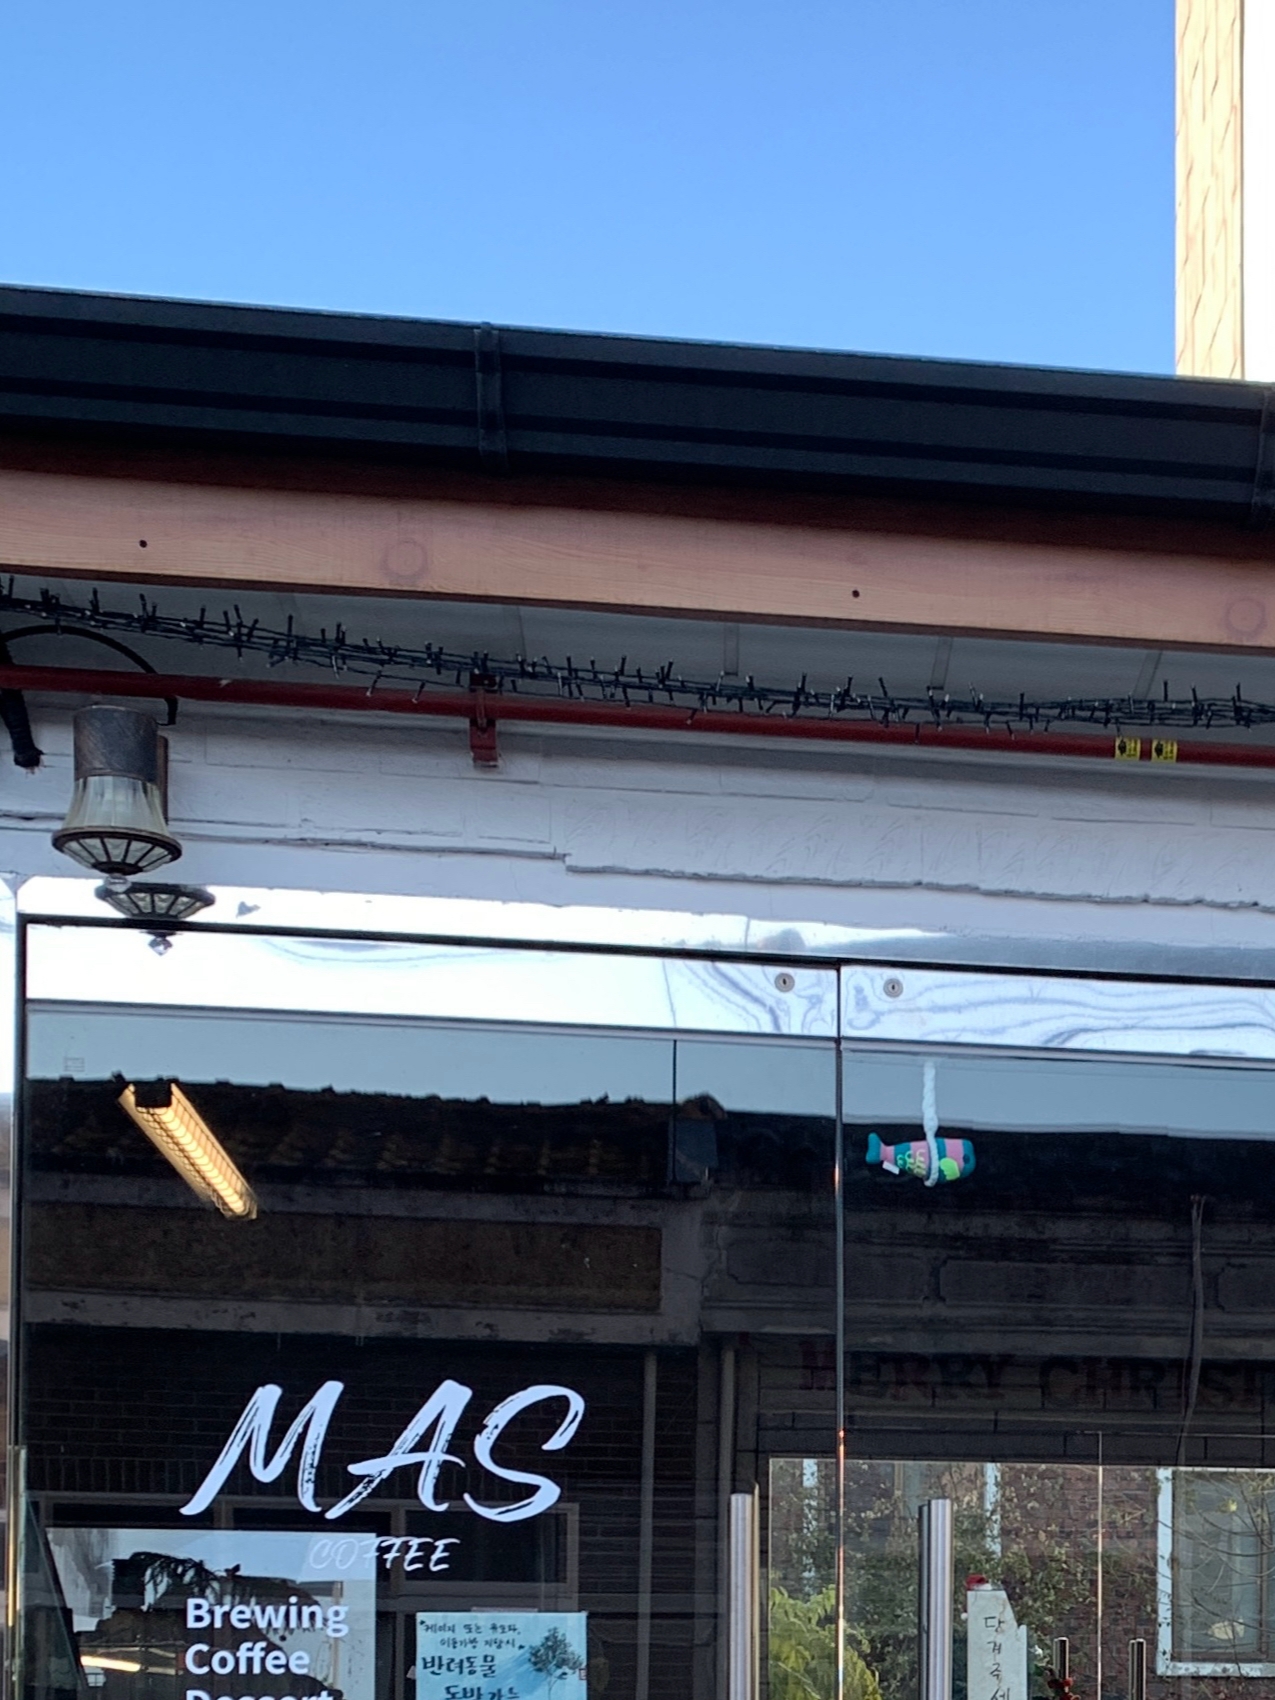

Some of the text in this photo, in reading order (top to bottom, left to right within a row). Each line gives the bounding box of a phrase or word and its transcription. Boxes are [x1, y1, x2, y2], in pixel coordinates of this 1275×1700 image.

[179, 1379, 585, 1522] MAS
[308, 1536, 460, 1572] COFFEE
[186, 1596, 349, 1638] Brewing
[185, 1641, 310, 1675] Coffee
[422, 1654, 496, 1678] 반려동물
